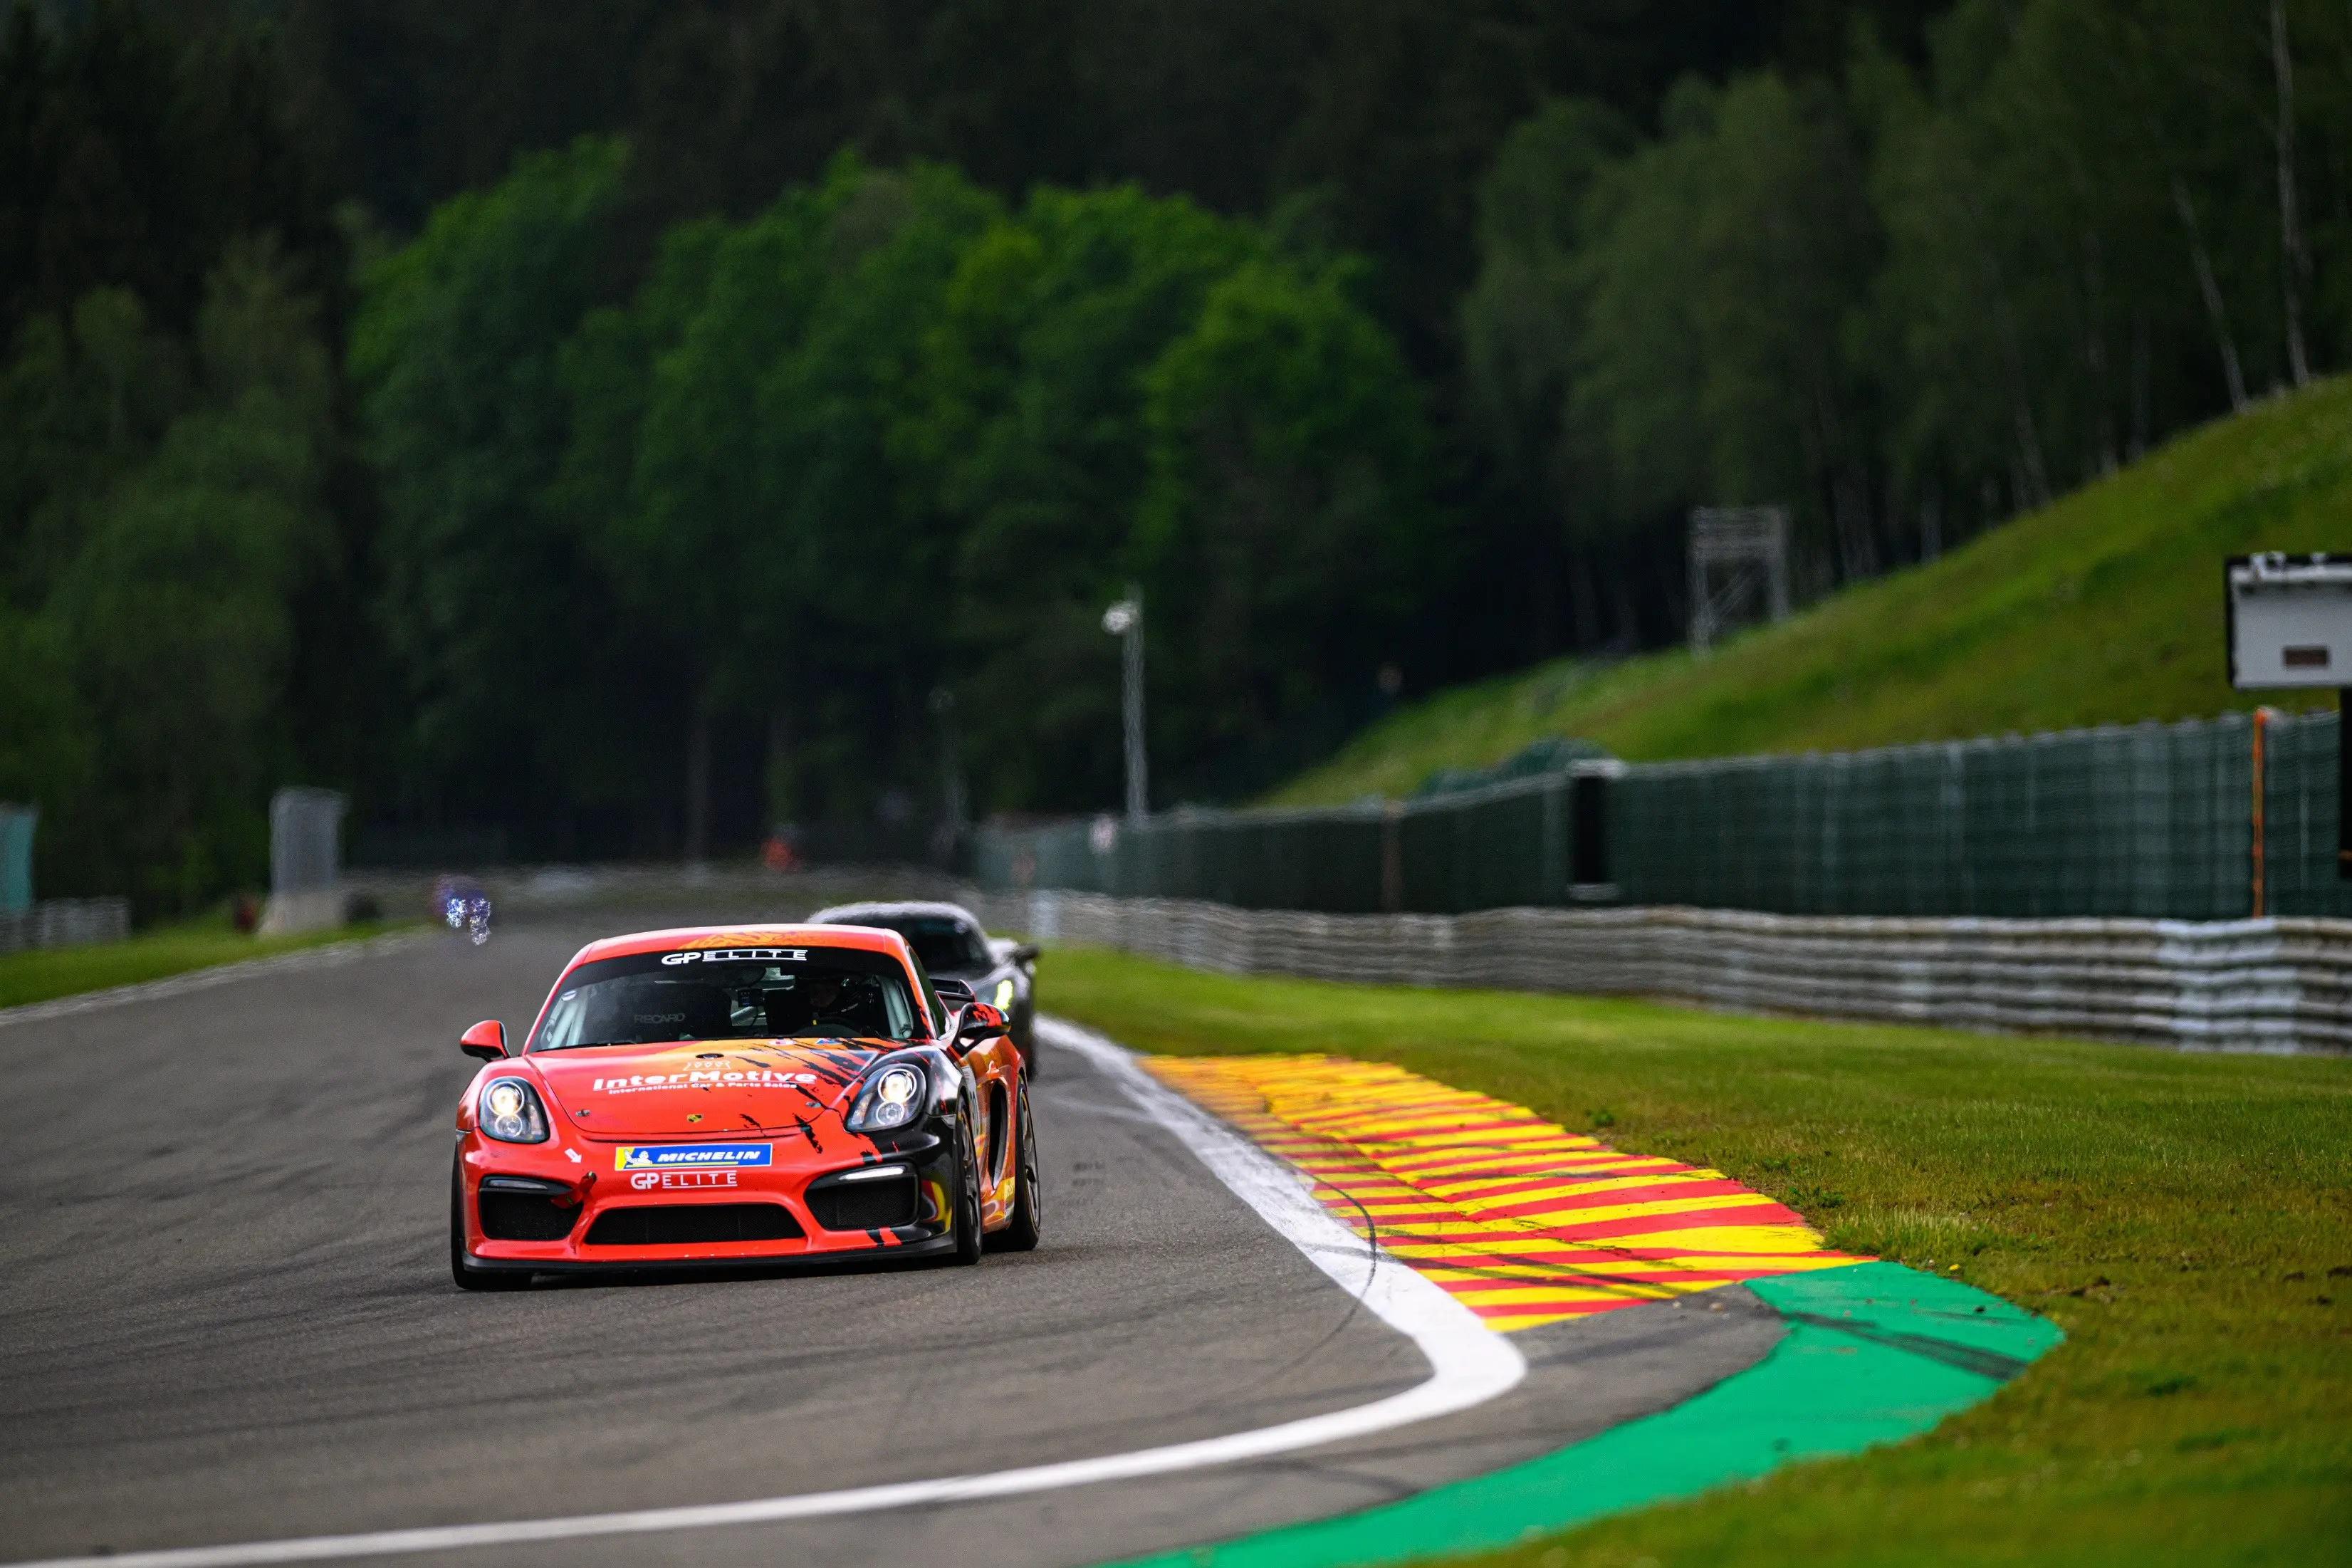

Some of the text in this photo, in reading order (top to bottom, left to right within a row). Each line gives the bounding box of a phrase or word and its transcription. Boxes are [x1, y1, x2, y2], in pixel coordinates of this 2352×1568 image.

[633, 1013, 686, 1024] RECARO
[593, 1070, 817, 1091] InterMotive
[608, 1083, 688, 1094] International
[657, 1151, 761, 1162] MICHELIN
